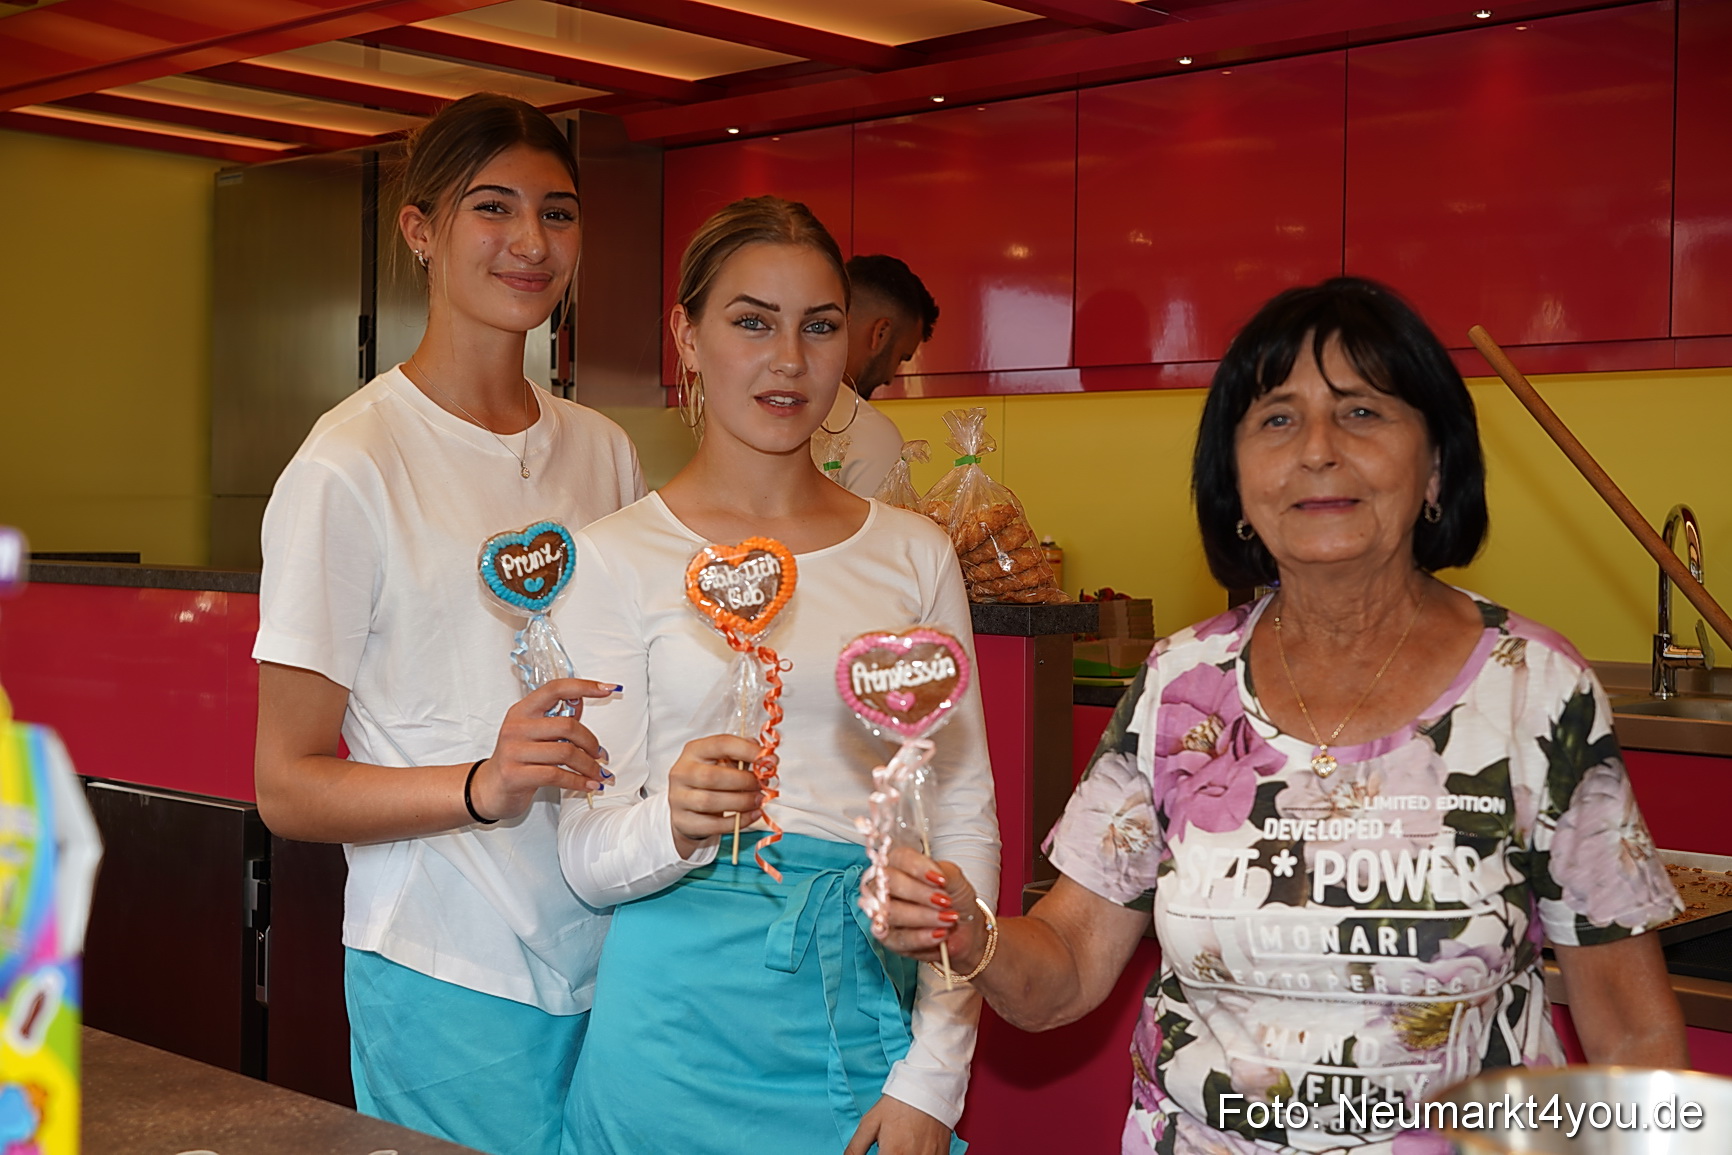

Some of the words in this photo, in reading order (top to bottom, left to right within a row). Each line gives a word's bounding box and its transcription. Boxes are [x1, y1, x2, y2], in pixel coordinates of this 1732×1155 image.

[501, 543, 561, 580] Prinz
[851, 654, 957, 696] Prinzessin
[1363, 795, 1431, 812] LIMITED
[1436, 794, 1507, 815] EDITION
[1262, 817, 1385, 841] DEVELOPED
[1388, 817, 1404, 840] 4
[1311, 846, 1486, 905] POWER
[1258, 925, 1418, 957] MONARI
